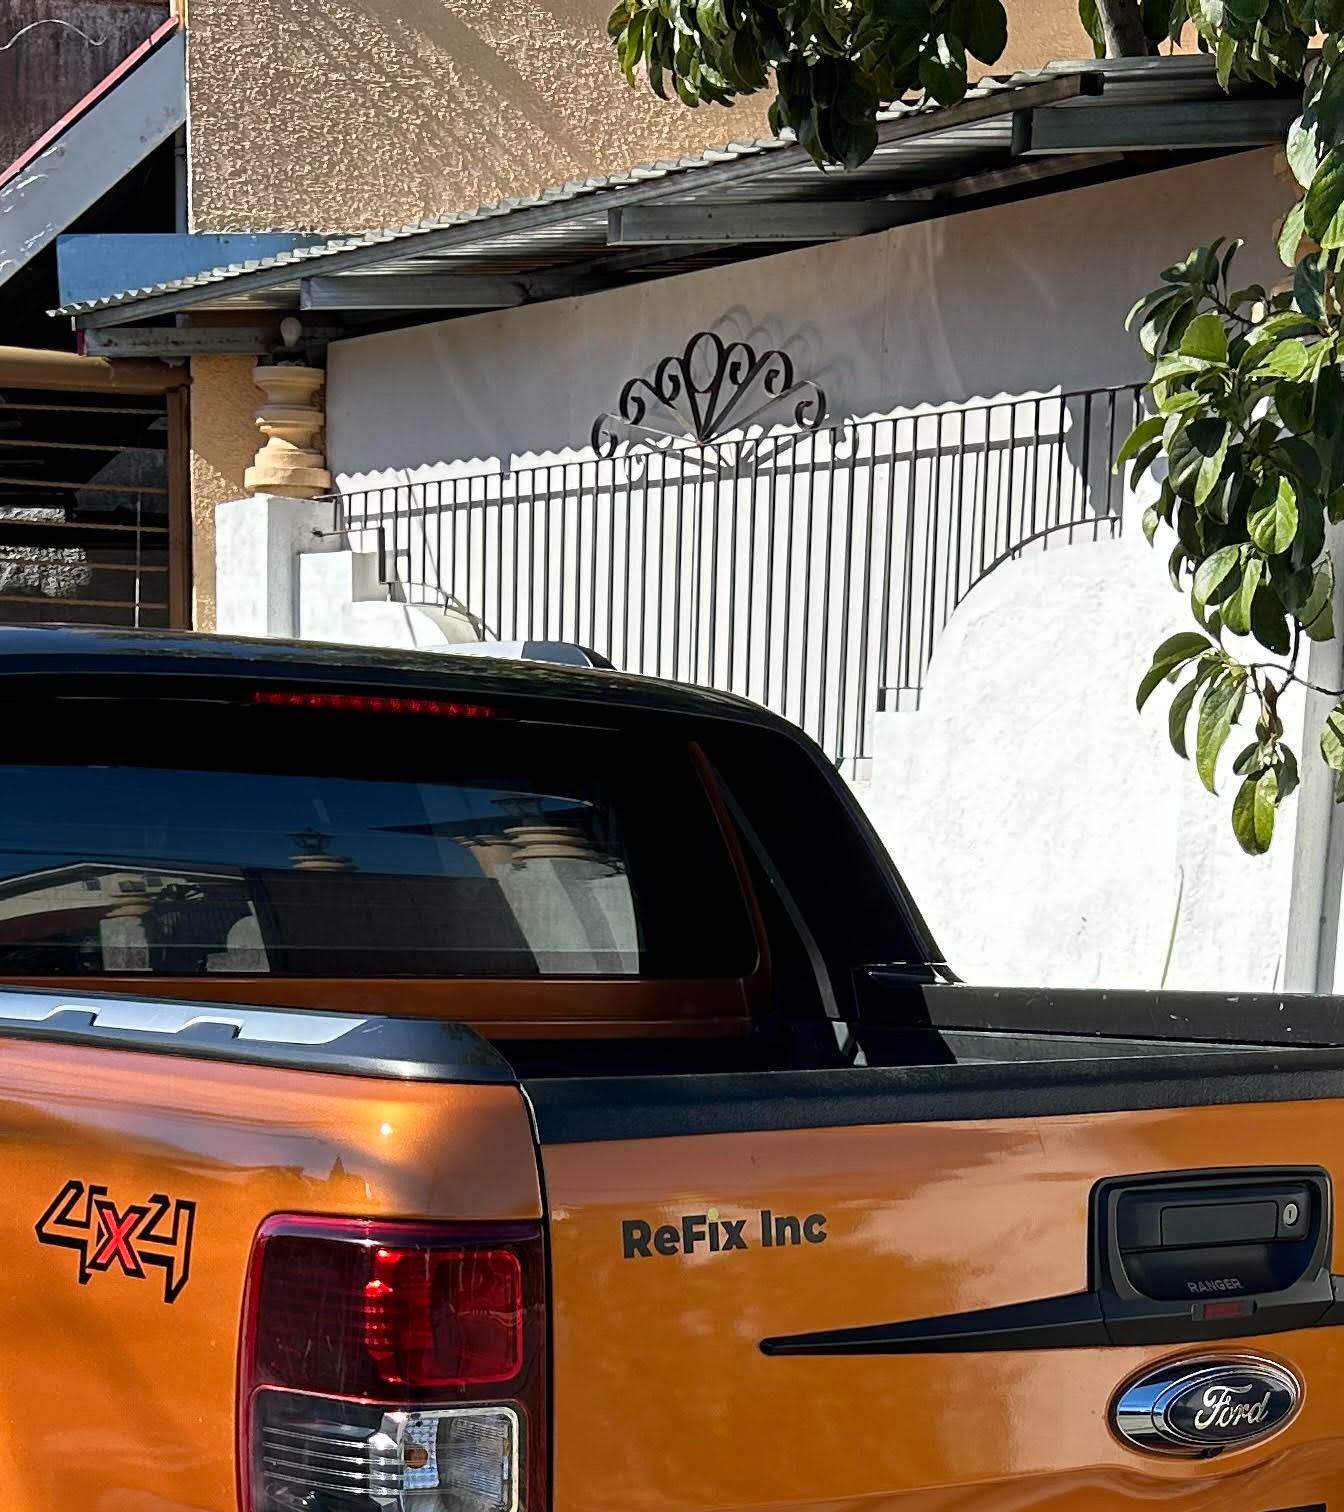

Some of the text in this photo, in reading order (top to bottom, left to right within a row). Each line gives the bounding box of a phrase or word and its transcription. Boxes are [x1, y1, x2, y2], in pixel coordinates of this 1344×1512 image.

[622, 1207, 827, 1259] ReFix Inc
[1186, 1278, 1244, 1294] RANGER
[1194, 1383, 1271, 1431] Ford
